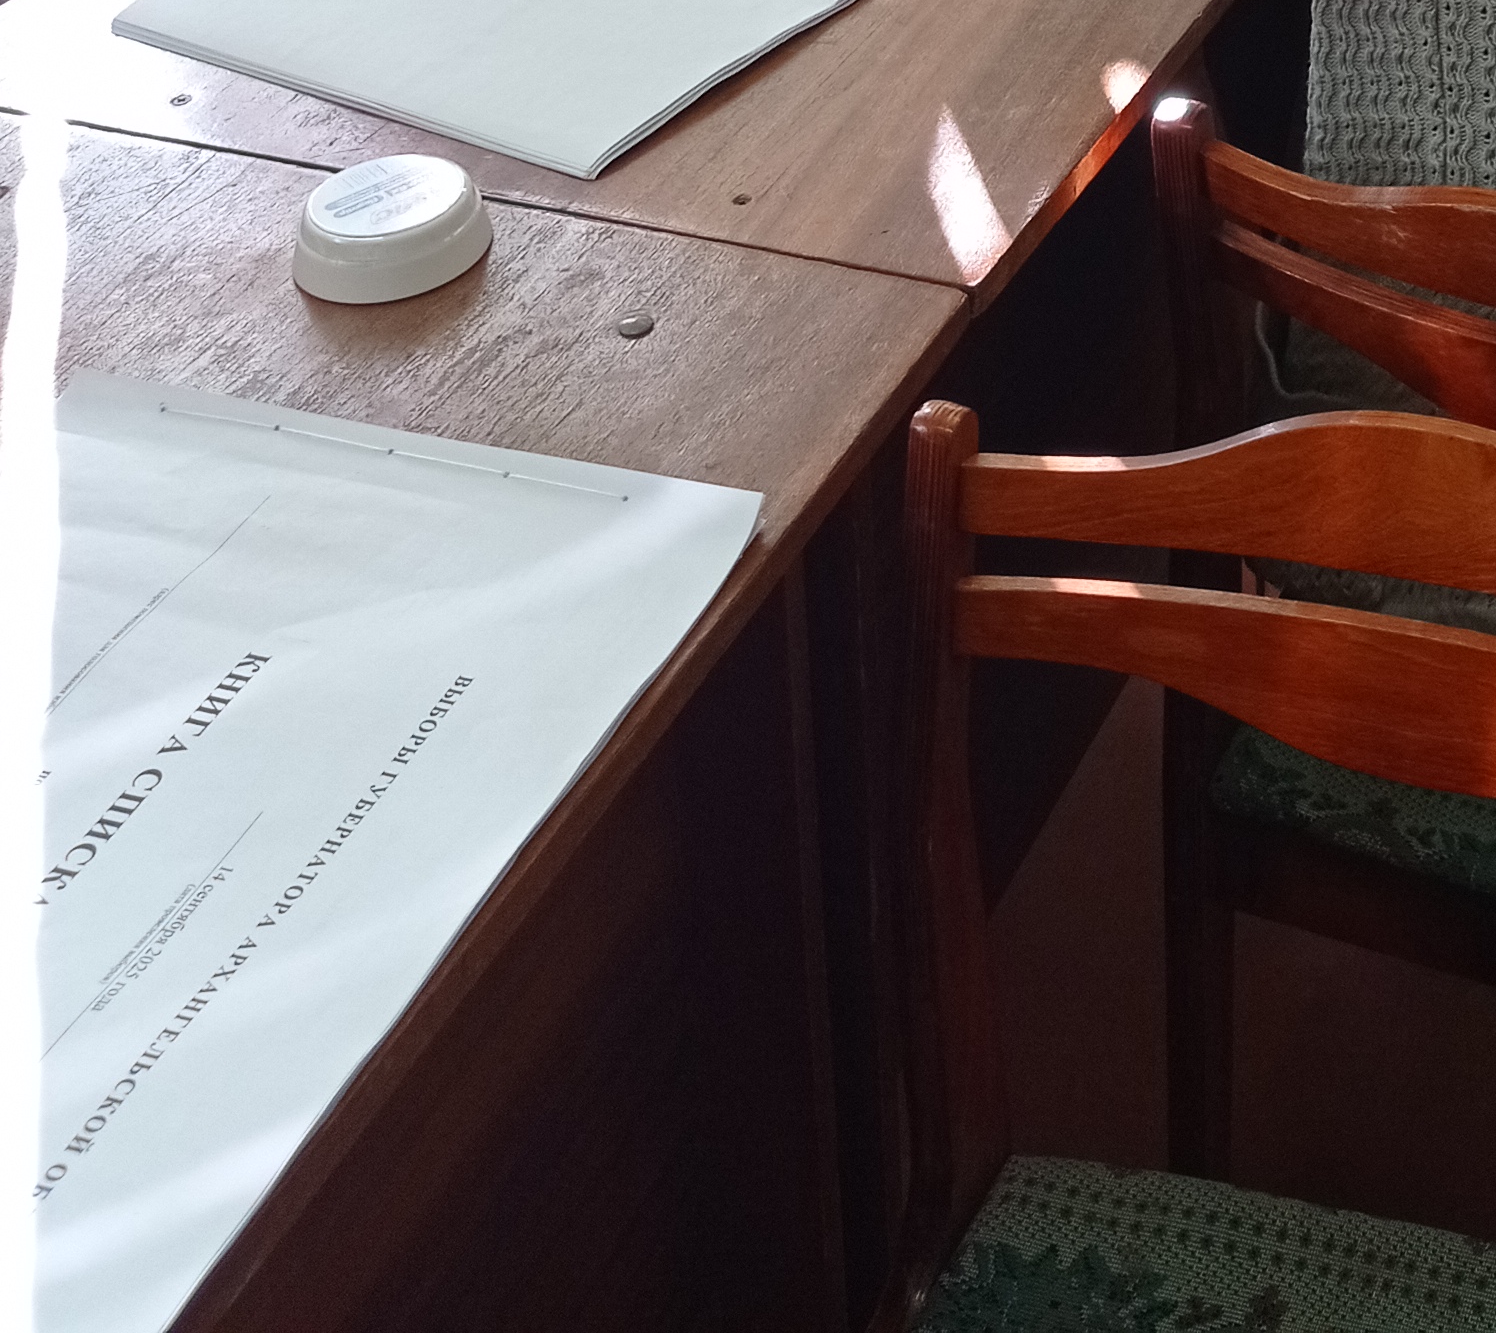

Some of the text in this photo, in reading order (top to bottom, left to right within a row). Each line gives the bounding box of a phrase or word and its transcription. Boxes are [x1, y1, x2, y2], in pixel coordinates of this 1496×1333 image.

[157, 652, 273, 755] КНИГА
[391, 675, 475, 765] ВЫБОРЫ
[256, 770, 399, 928] ГУБЕРНАТОРА
[91, 866, 234, 1012] 14 сентября 2025 года
[64, 936, 258, 1154] АРХАНГЕЛЬСКОЙ
